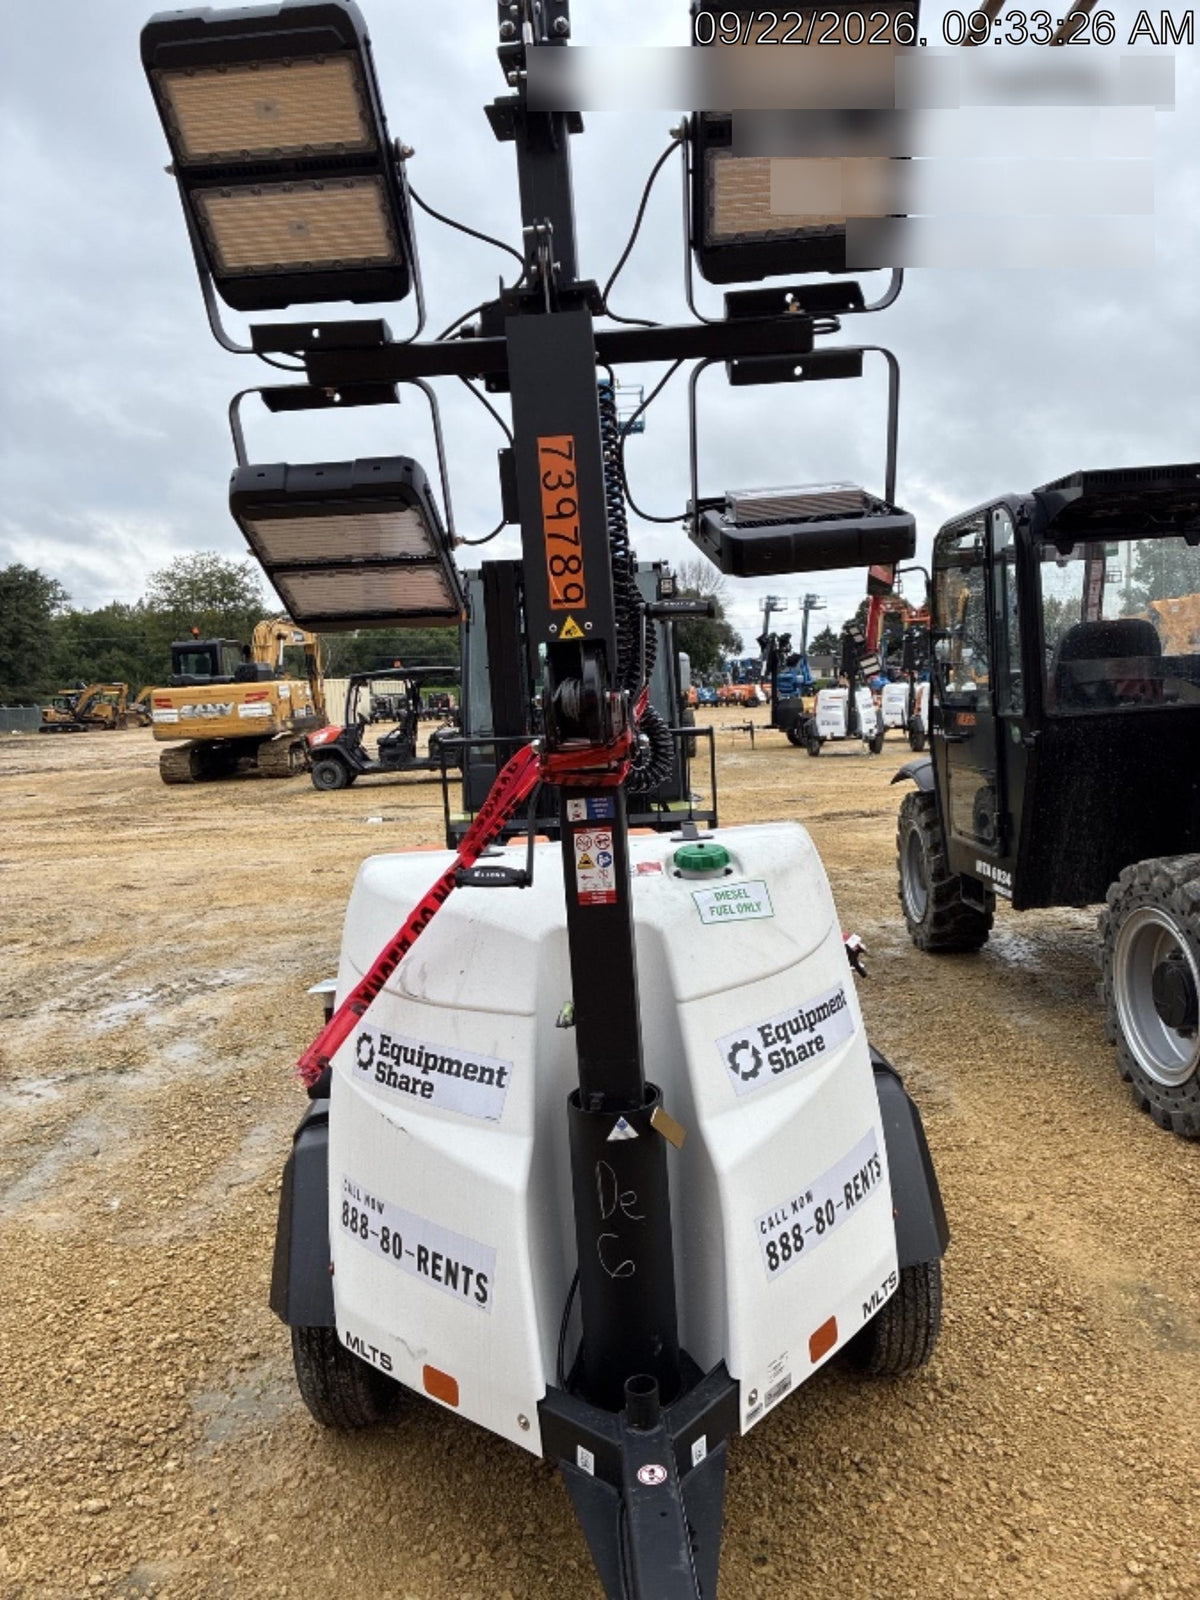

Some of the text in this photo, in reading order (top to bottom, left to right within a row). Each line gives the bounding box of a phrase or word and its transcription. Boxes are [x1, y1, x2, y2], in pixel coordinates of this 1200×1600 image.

[540, 441, 584, 604] 739789
[709, 902, 762, 916] FUEL ONLY
[714, 888, 750, 901] DIESEL
[378, 1034, 509, 1088] Equipment
[767, 1034, 826, 1074] Share
[374, 1060, 435, 1099] Share
[760, 1209, 788, 1235] CALL
[765, 1151, 882, 1272] 888-80-RENTS
[342, 1199, 489, 1304] 888-80-RENTS
[861, 1270, 898, 1320] MLTS
[345, 1330, 393, 1372] MLTS
